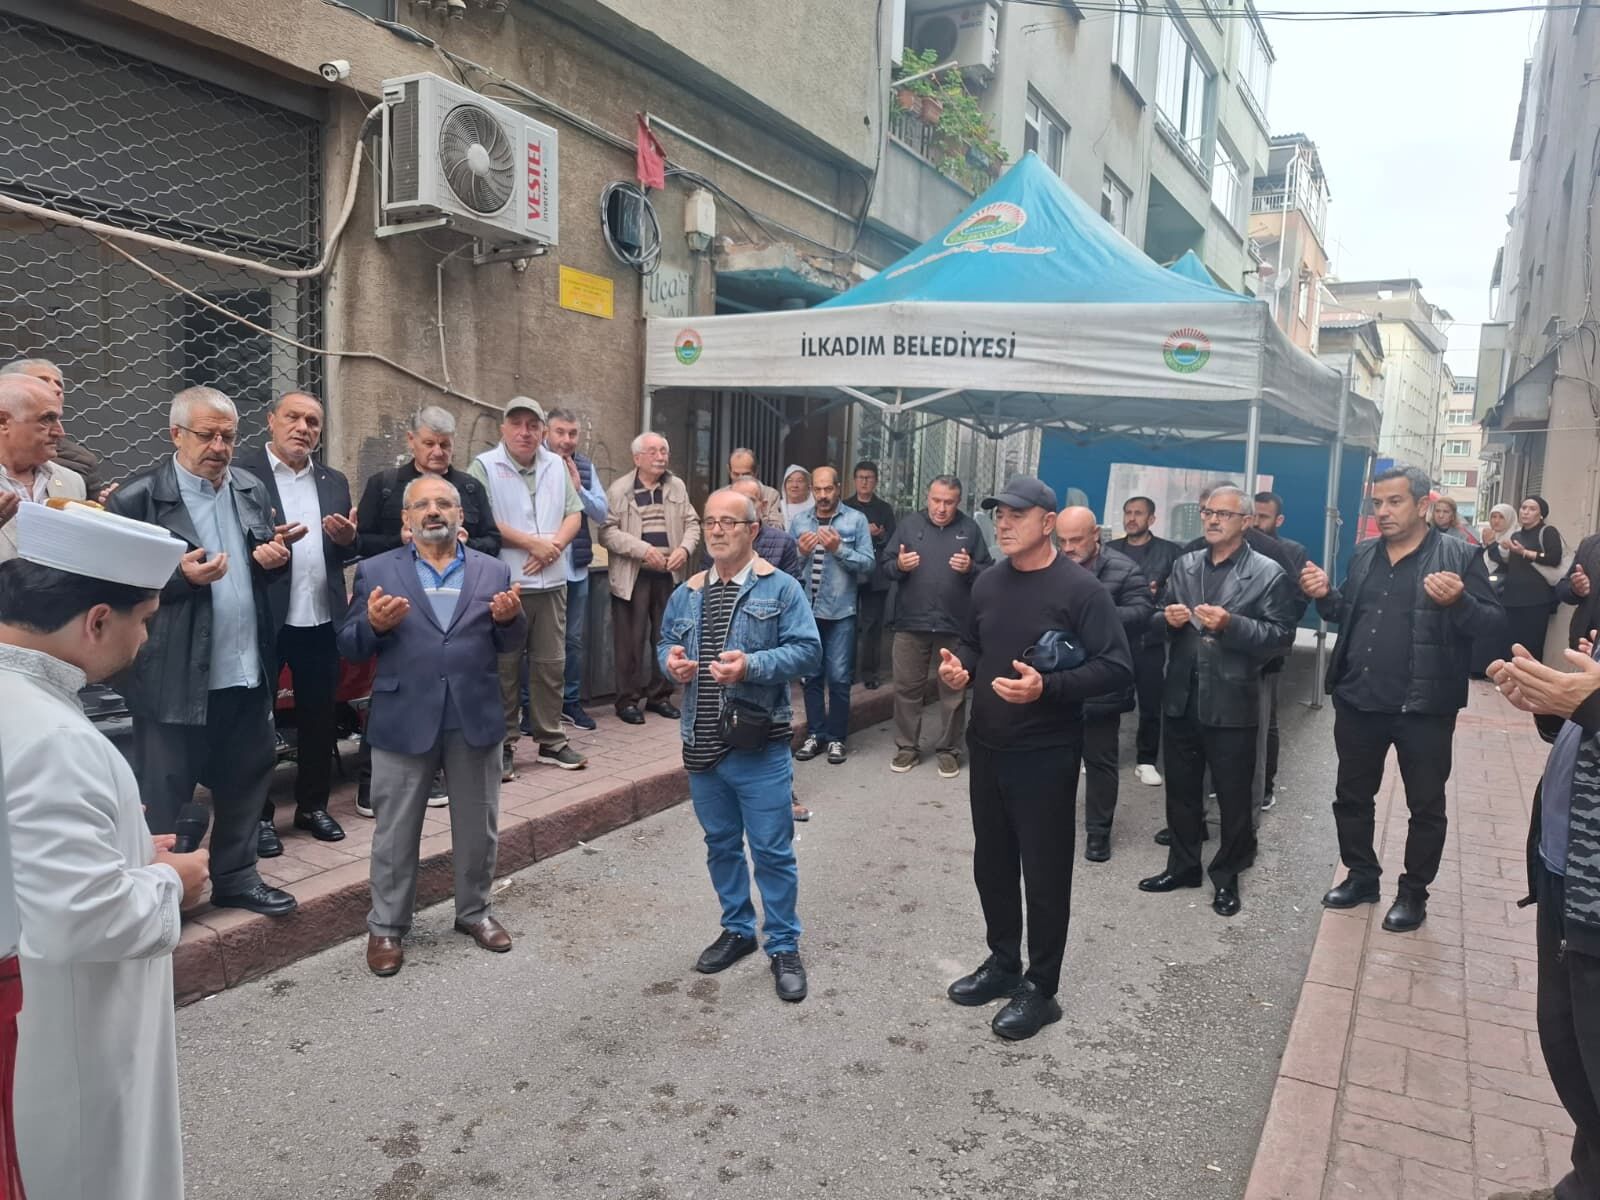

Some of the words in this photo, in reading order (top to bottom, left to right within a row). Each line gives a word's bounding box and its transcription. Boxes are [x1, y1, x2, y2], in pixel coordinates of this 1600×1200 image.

[527, 140, 541, 219] VESTEL
[801, 332, 886, 357] İLKADIM
[893, 330, 1016, 359] BELEDİYESİ
